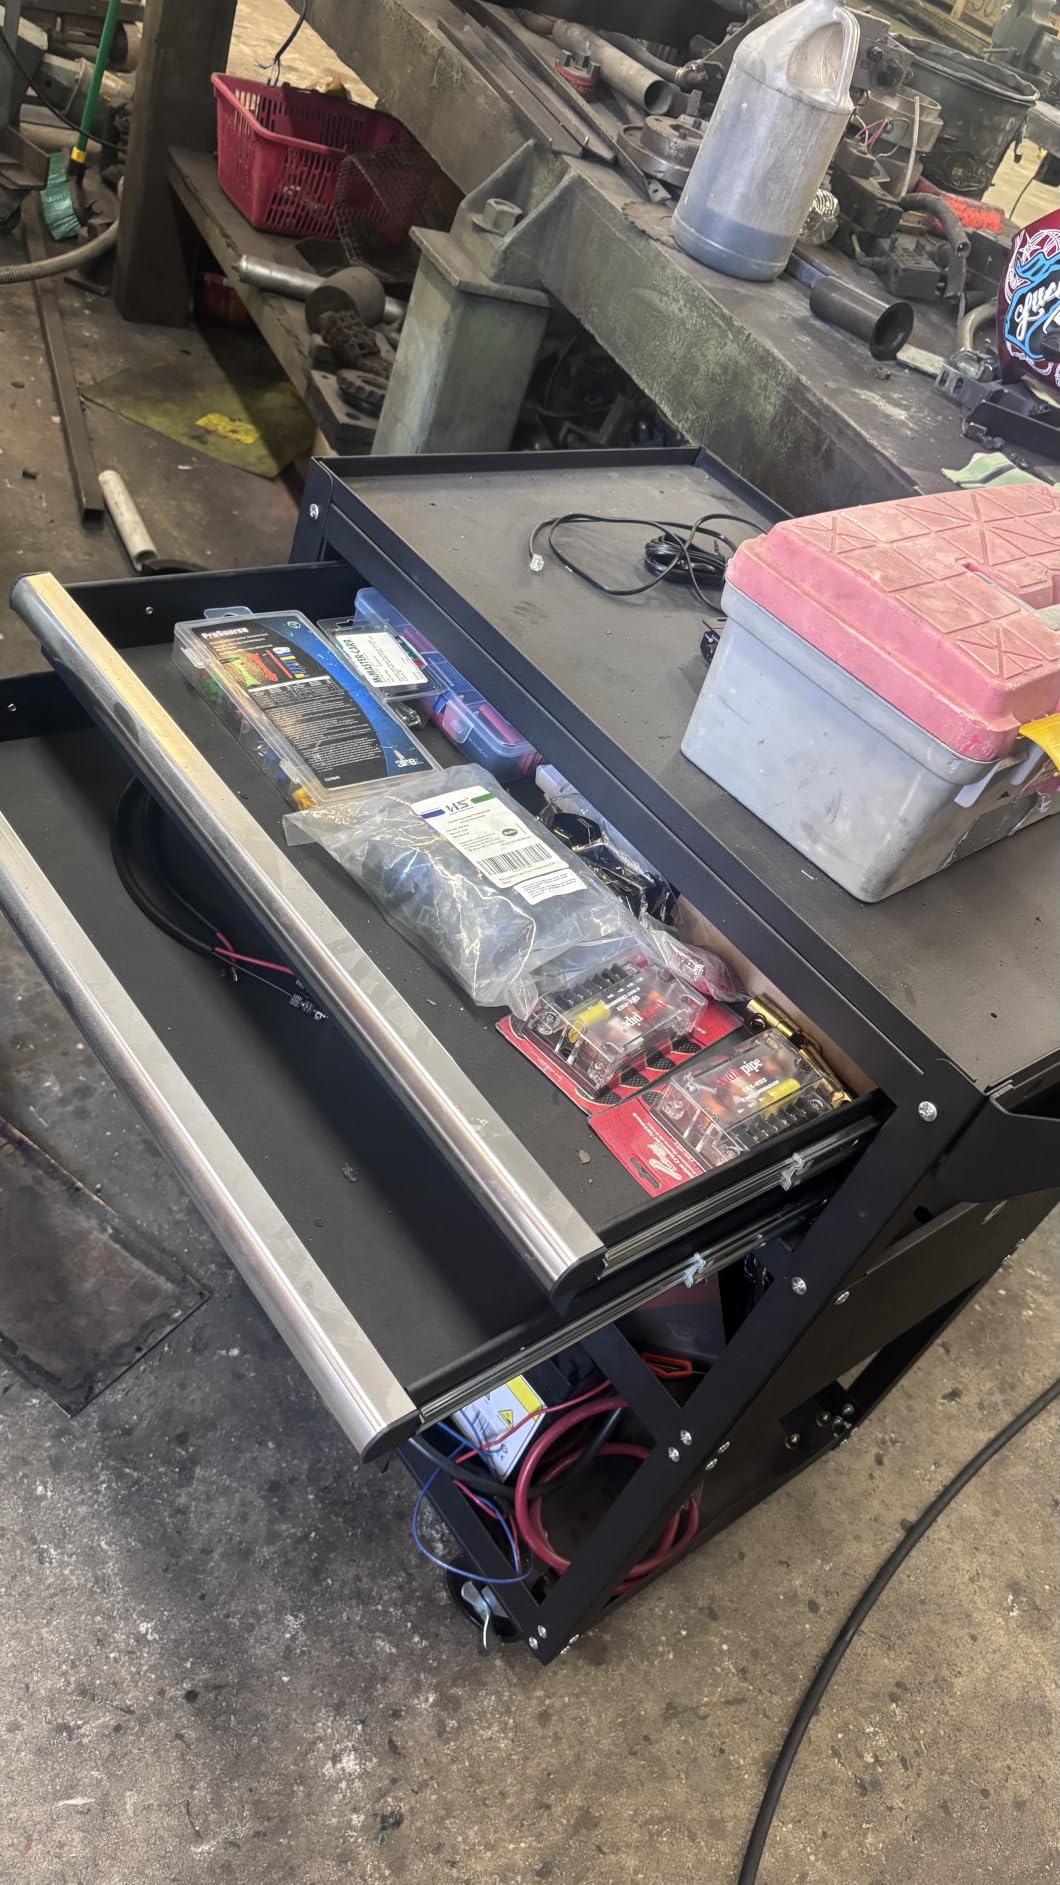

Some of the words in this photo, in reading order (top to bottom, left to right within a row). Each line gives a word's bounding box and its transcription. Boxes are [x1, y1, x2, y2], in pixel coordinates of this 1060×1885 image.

[1015, 280, 1060, 341] Luc
[201, 627, 249, 640] ProSource
[344, 639, 383, 683] McMASTER-CARR
